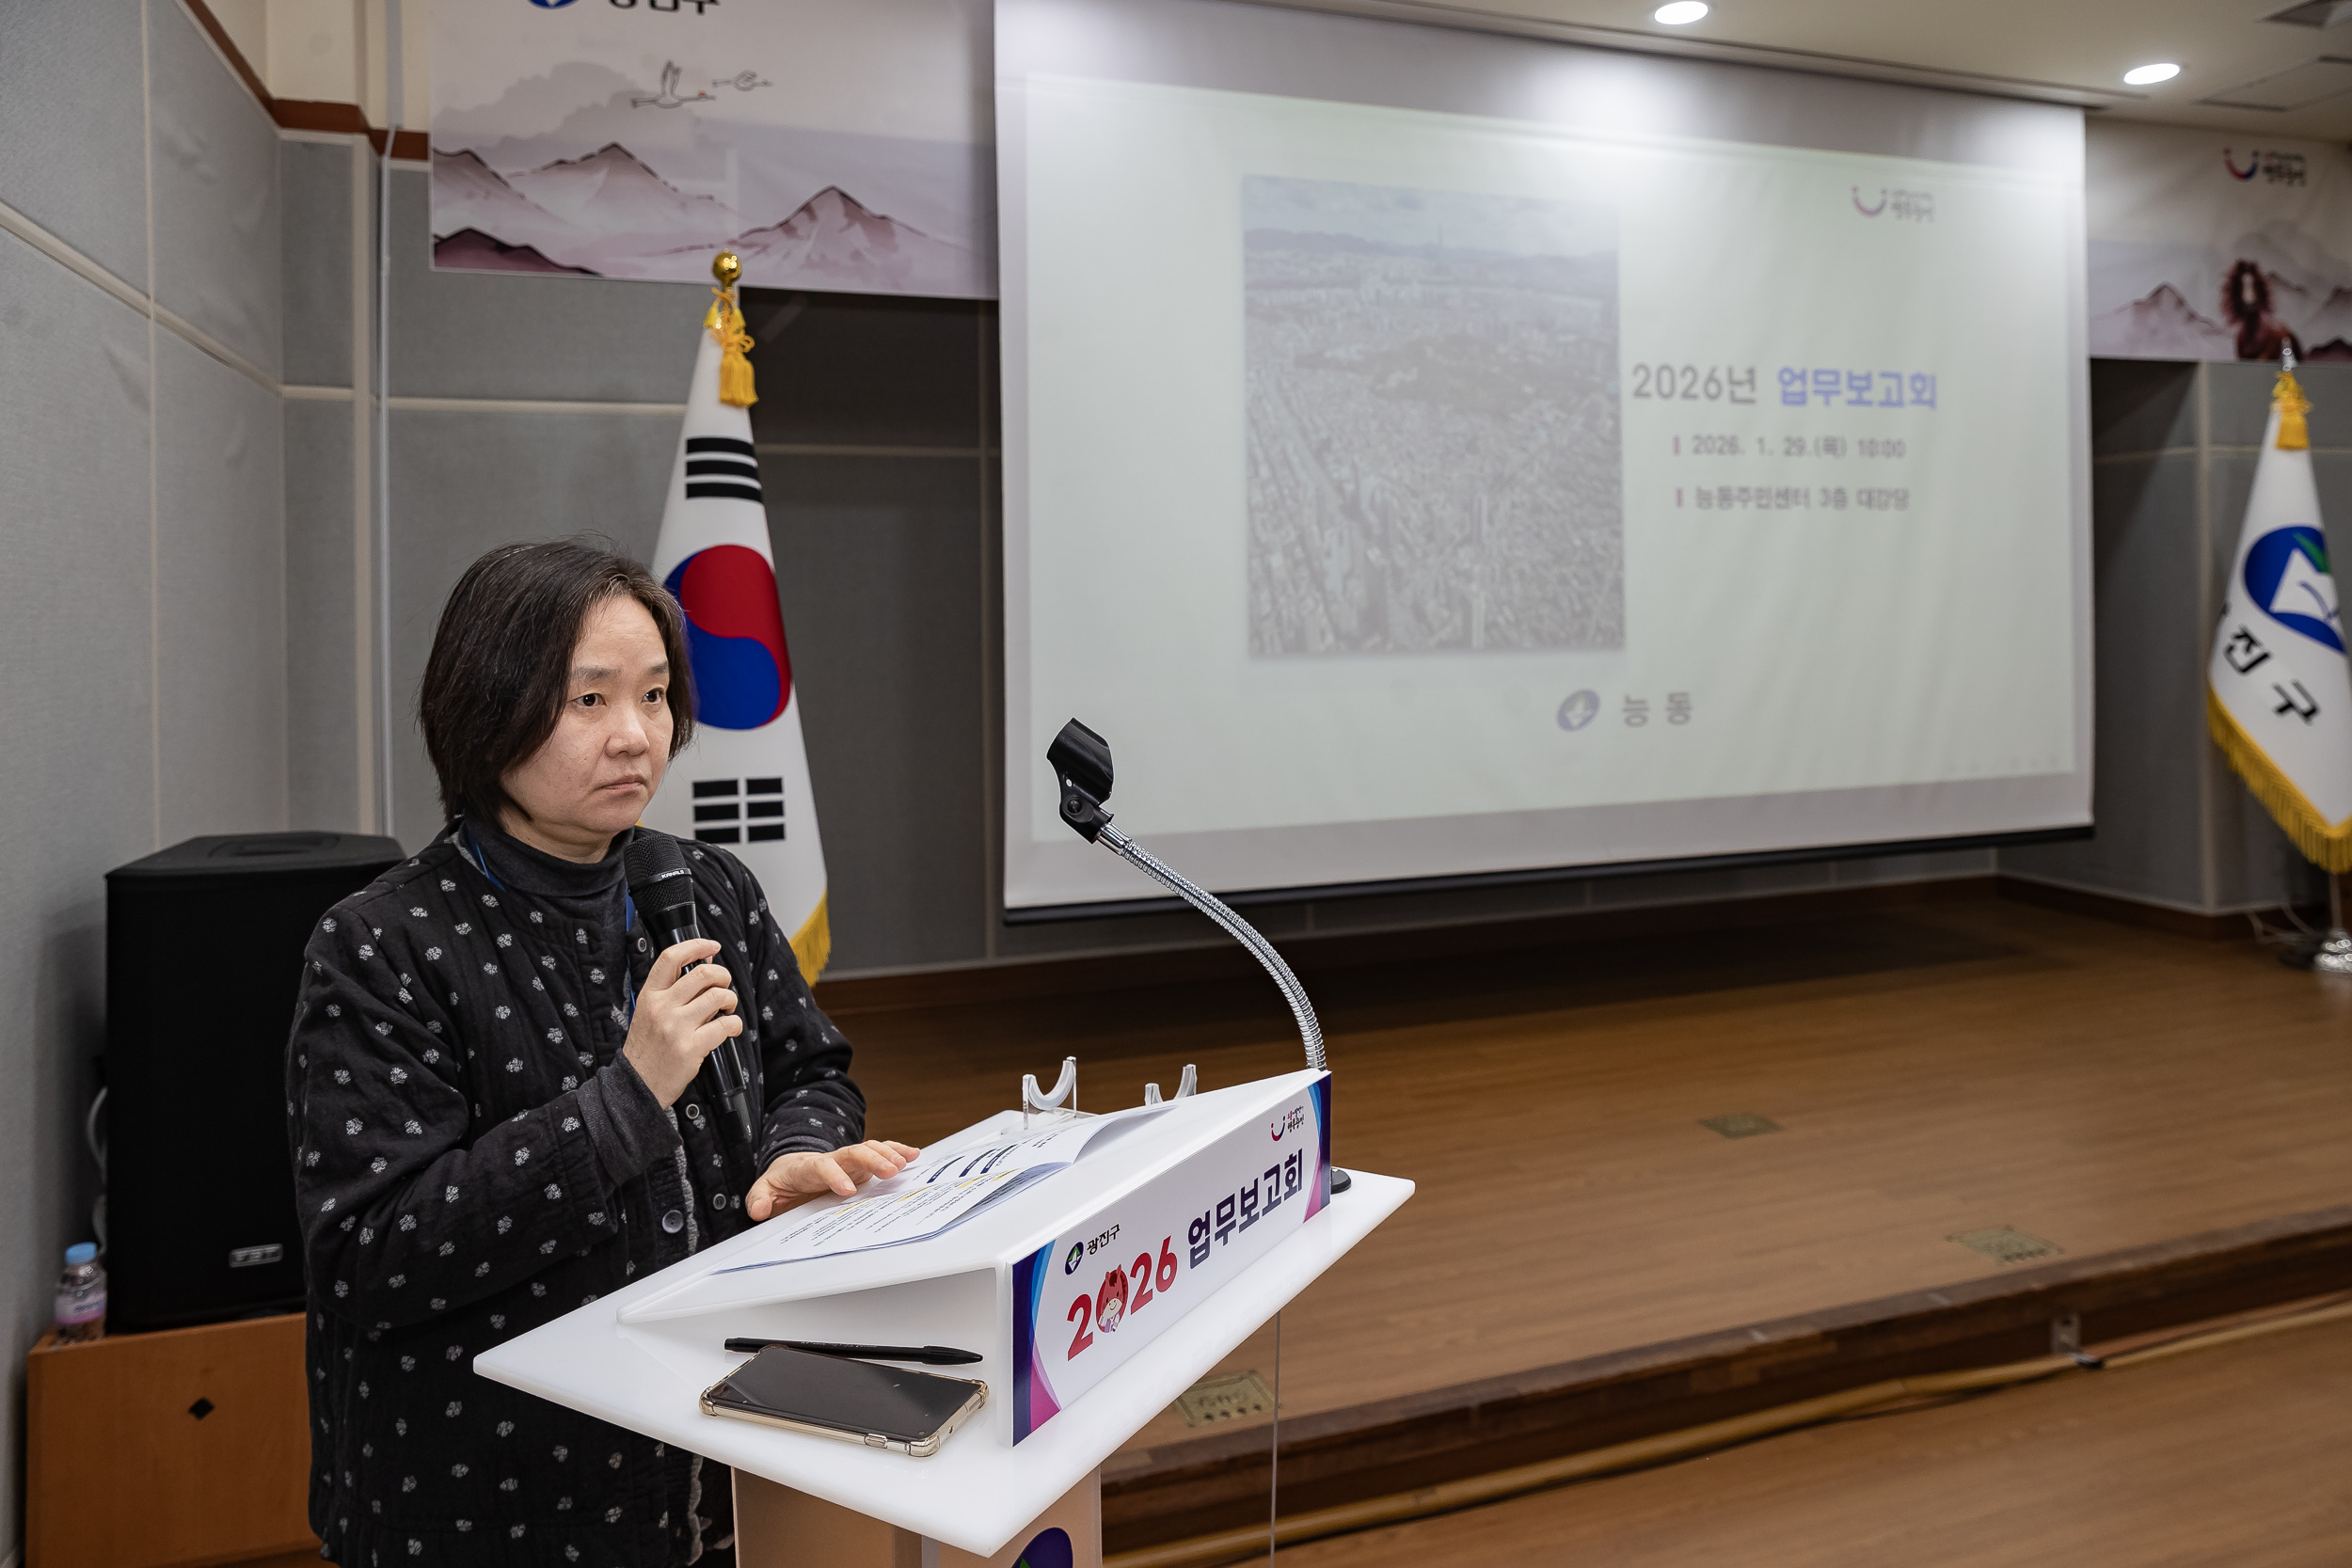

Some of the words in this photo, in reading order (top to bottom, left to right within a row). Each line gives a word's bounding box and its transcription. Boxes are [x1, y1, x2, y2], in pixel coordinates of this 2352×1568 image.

[1631, 361, 1757, 405] 2026년
[1776, 365, 1939, 411] 업무보고회
[1067, 1235, 1178, 1361] 2026
[1187, 1148, 1303, 1269] 업무보고회
[1087, 1224, 1121, 1256] 광진구
